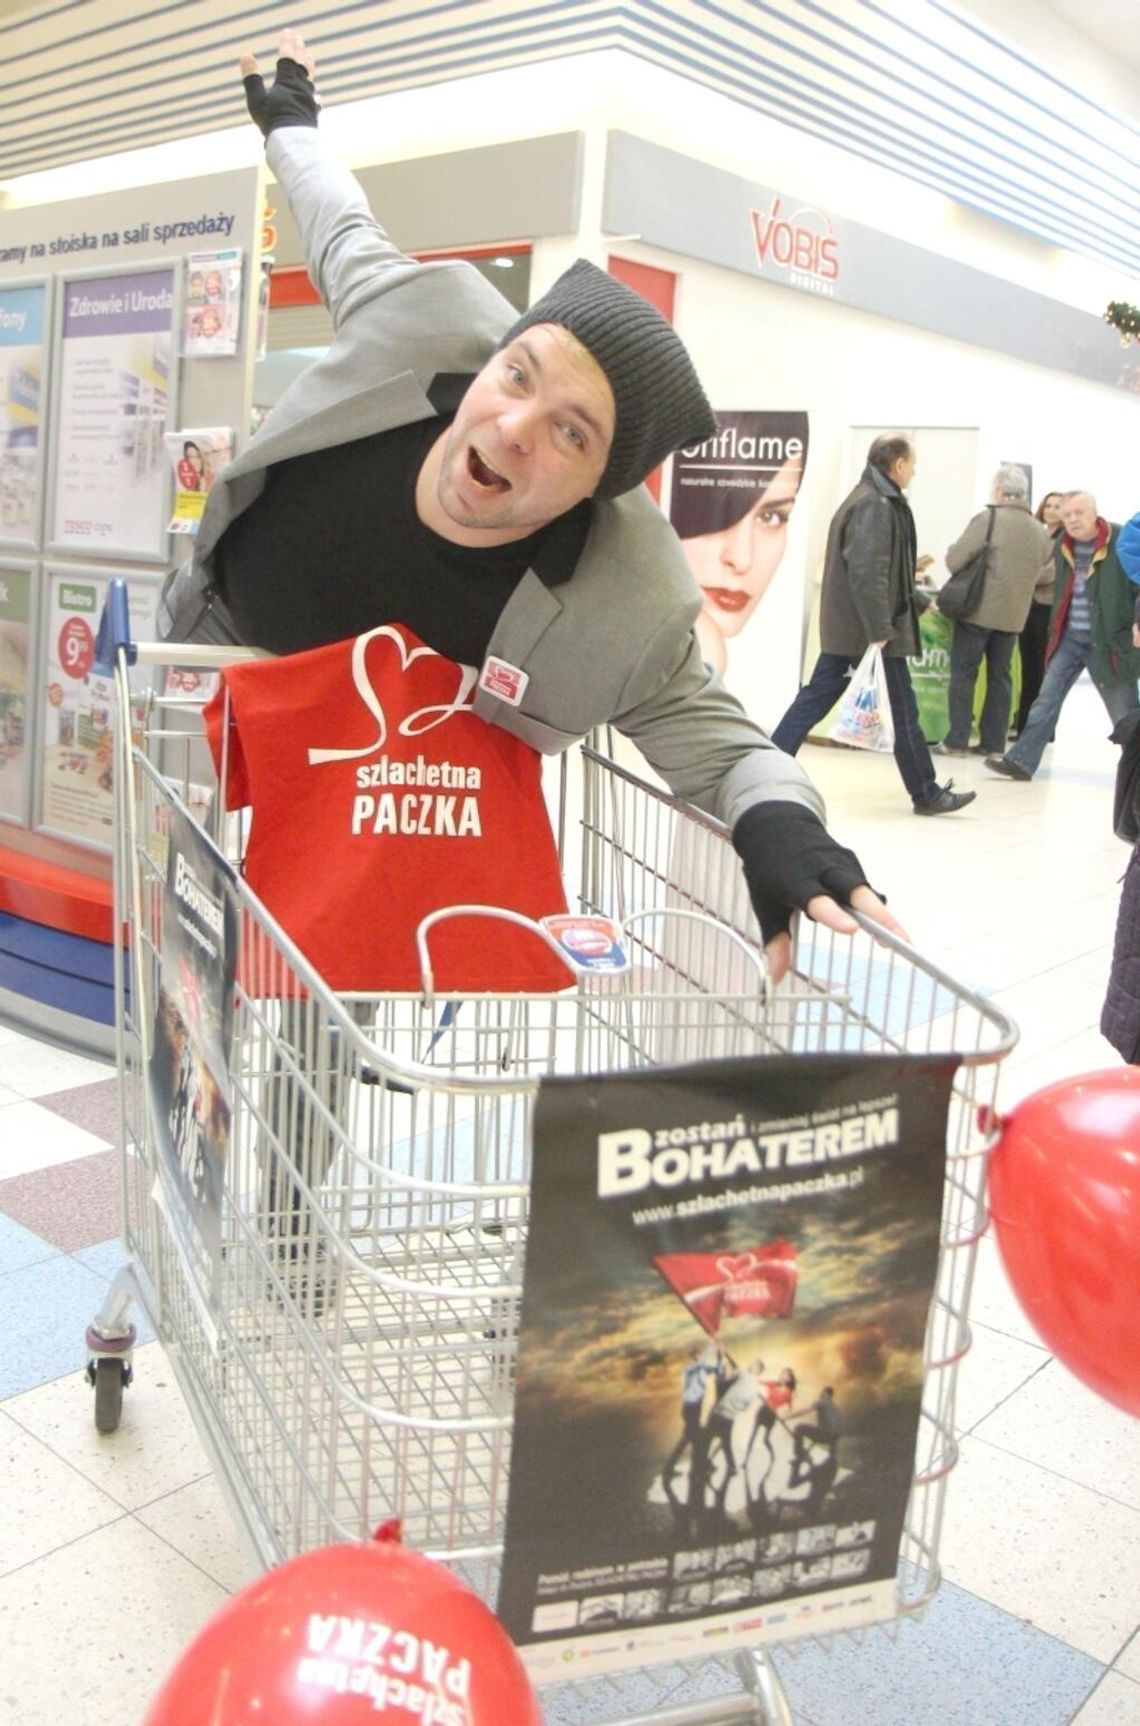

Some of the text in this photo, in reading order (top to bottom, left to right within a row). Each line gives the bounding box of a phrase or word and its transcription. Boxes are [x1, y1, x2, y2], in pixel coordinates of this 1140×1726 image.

[30, 242, 46, 258] na
[49, 231, 98, 256] stoiska
[102, 230, 119, 248] na
[123, 221, 150, 246] sali
[153, 211, 236, 246] sprzedaży
[749, 197, 840, 281] VOBIS
[69, 288, 174, 318] Zdrowie i Uroda
[789, 271, 835, 296] DIGITAL
[356, 754, 482, 790] szlachetna
[351, 793, 483, 838] PACZKA
[597, 1107, 900, 1198] BOHATEREM
[654, 1113, 746, 1147] zostań
[632, 1165, 864, 1226] www.szlachetnapaczka.pl
[308, 1612, 472, 1698] PACZKA
